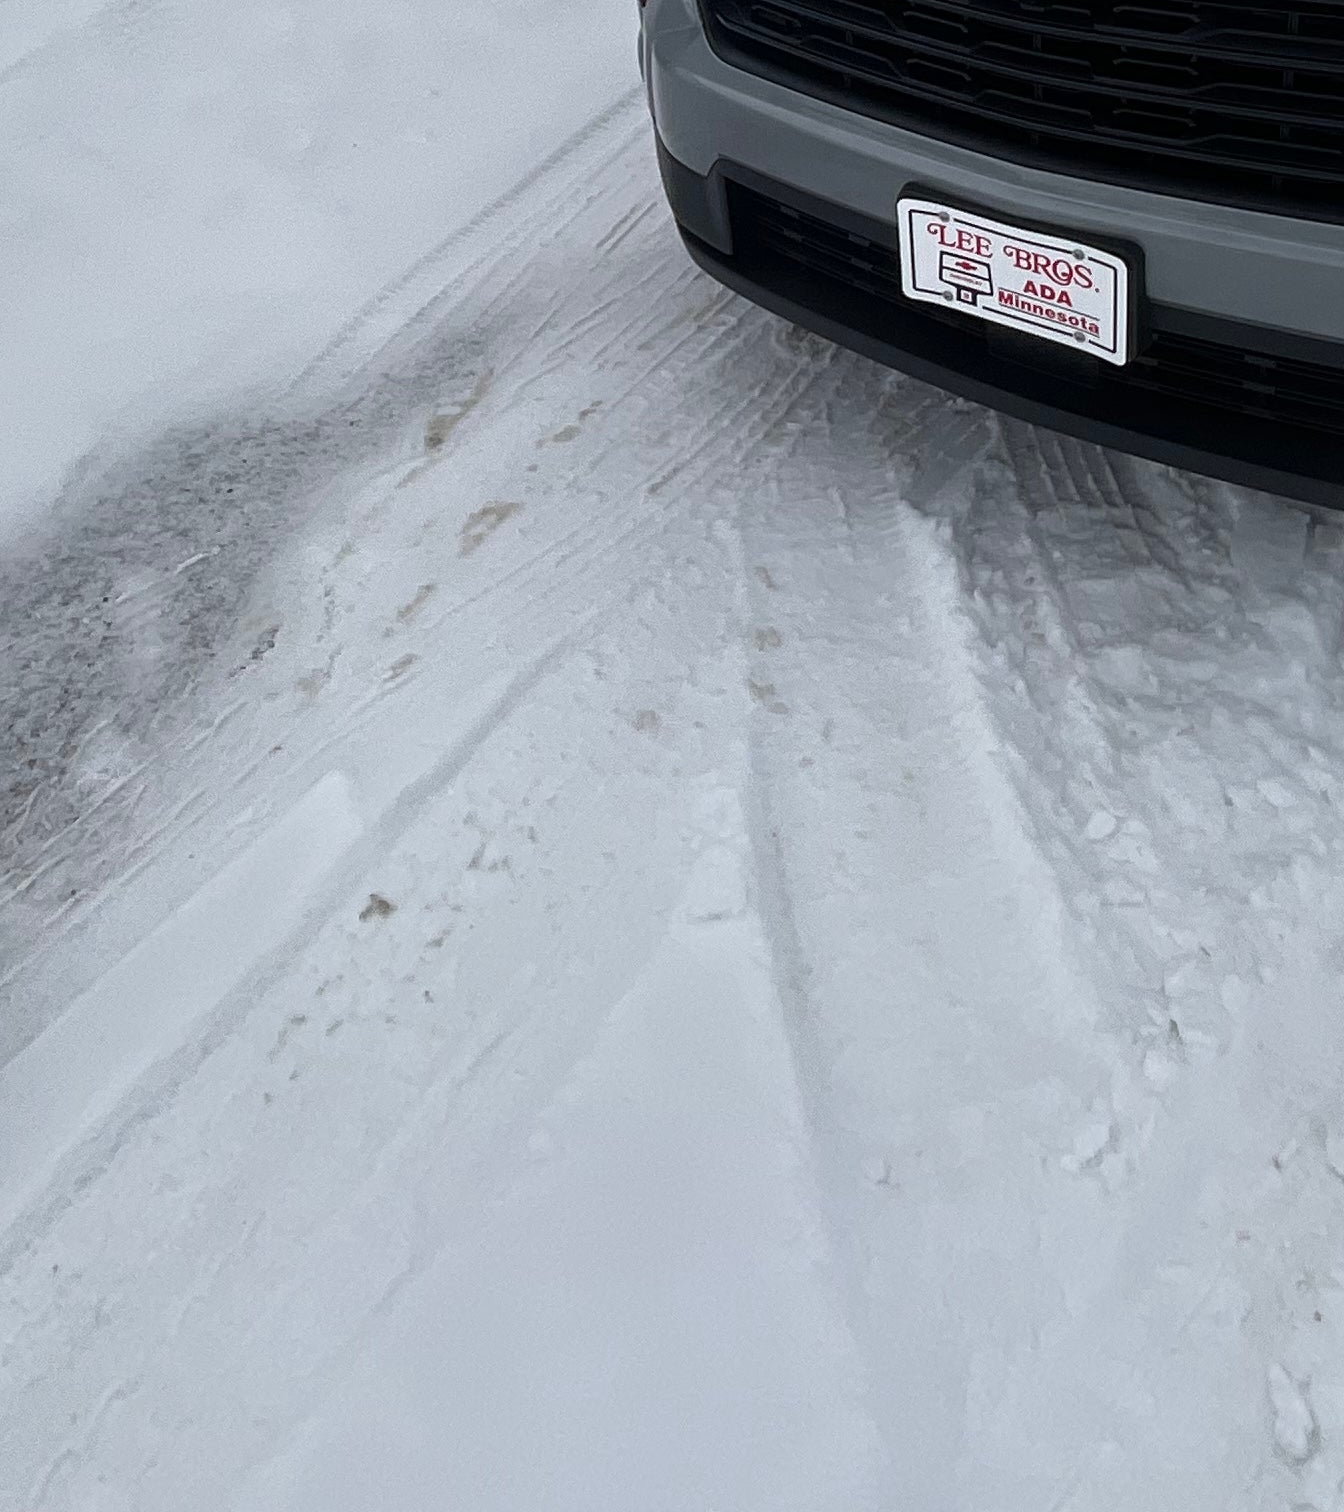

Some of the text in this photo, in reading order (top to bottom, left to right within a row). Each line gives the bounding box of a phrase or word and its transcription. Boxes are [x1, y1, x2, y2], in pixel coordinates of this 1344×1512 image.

[927, 222, 994, 259] LEE
[998, 290, 1100, 335] Minnesota
[1023, 280, 1073, 308] ADA
